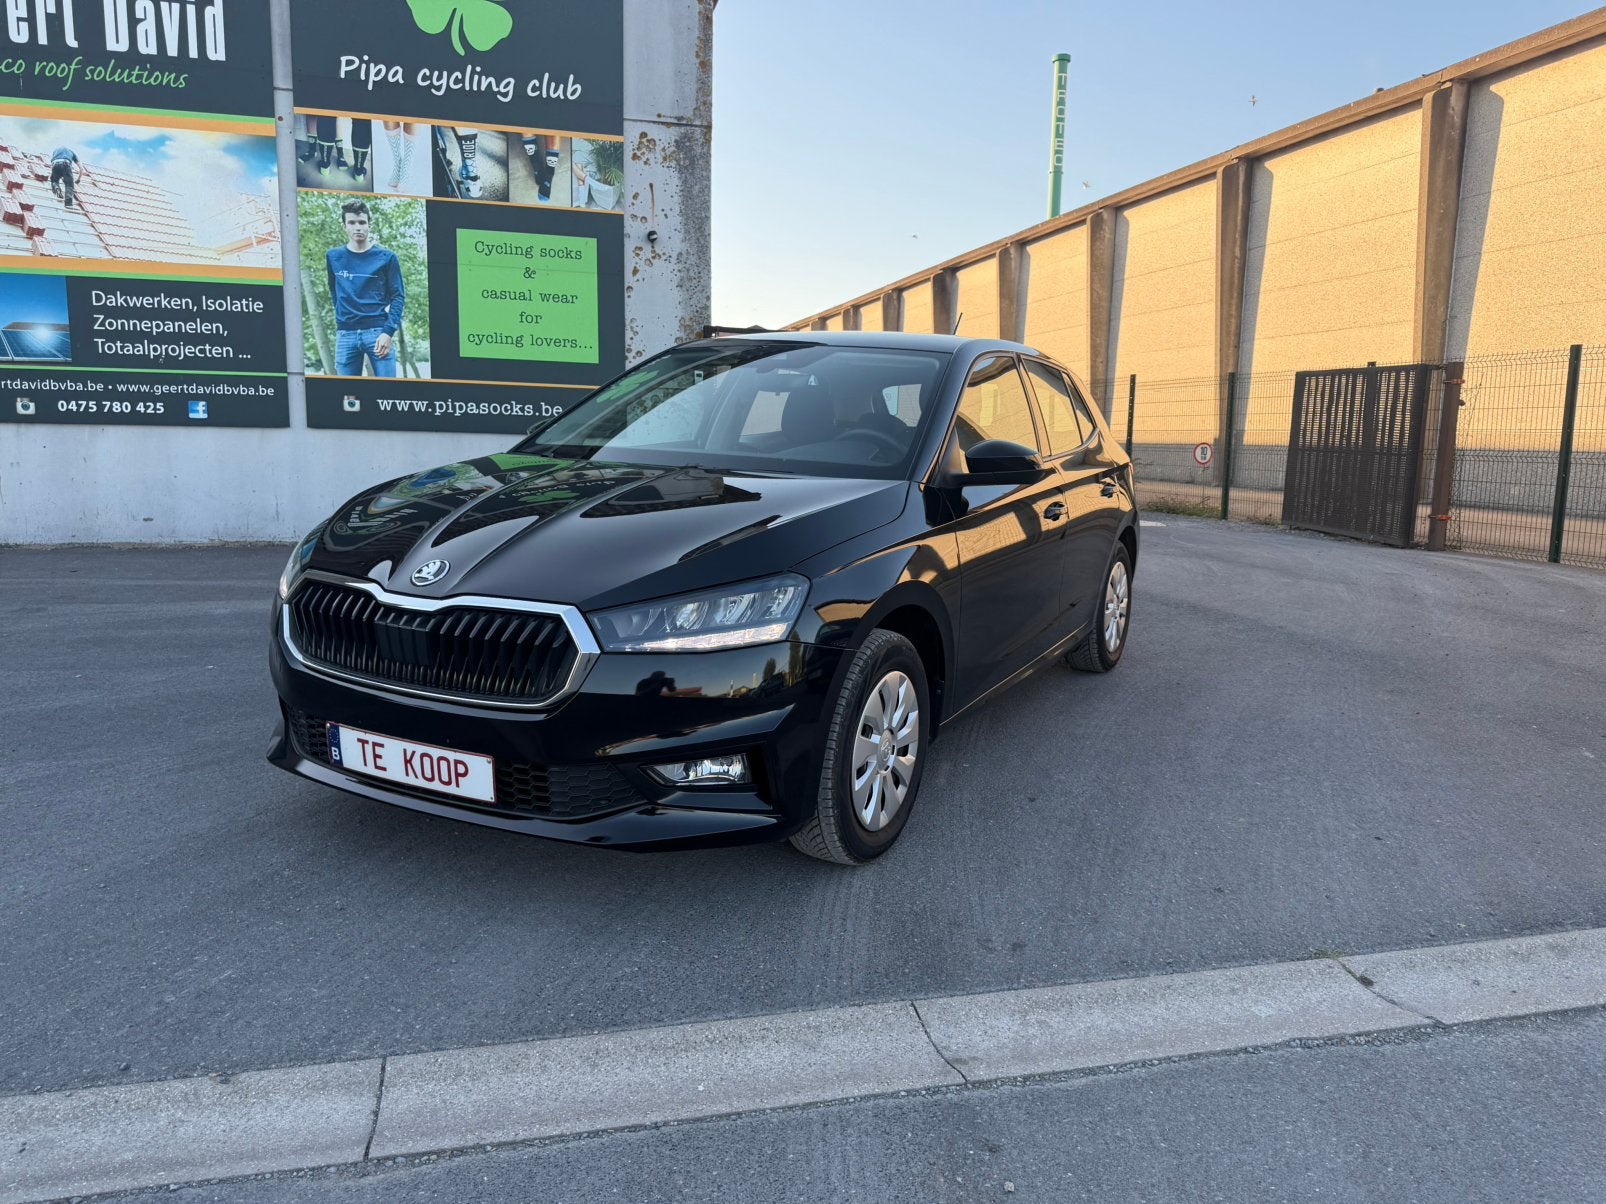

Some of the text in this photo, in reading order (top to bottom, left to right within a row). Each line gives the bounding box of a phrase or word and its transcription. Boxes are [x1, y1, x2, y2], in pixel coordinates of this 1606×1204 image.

[103, 0, 226, 61] David
[0, 56, 189, 91] co roof solutions
[339, 55, 582, 102] Pipa cycling club
[462, 139, 476, 158] RIDE
[474, 240, 583, 260] Cycling socks
[523, 266, 537, 280] &
[92, 290, 264, 313] Dakwerken, Isolatie
[481, 289, 578, 304] casual wear
[93, 315, 228, 336] Zonnepanelen,
[519, 311, 543, 325] for
[94, 339, 234, 359] Totaalprojecten
[467, 332, 593, 349] cycling lovers...
[116, 382, 275, 397] www.geertdavidbvba.be
[57, 400, 165, 414] 0475 780 425
[376, 398, 563, 417] www.pipasocks.be
[332, 747, 340, 760] B
[357, 738, 469, 788] TE KOOP
